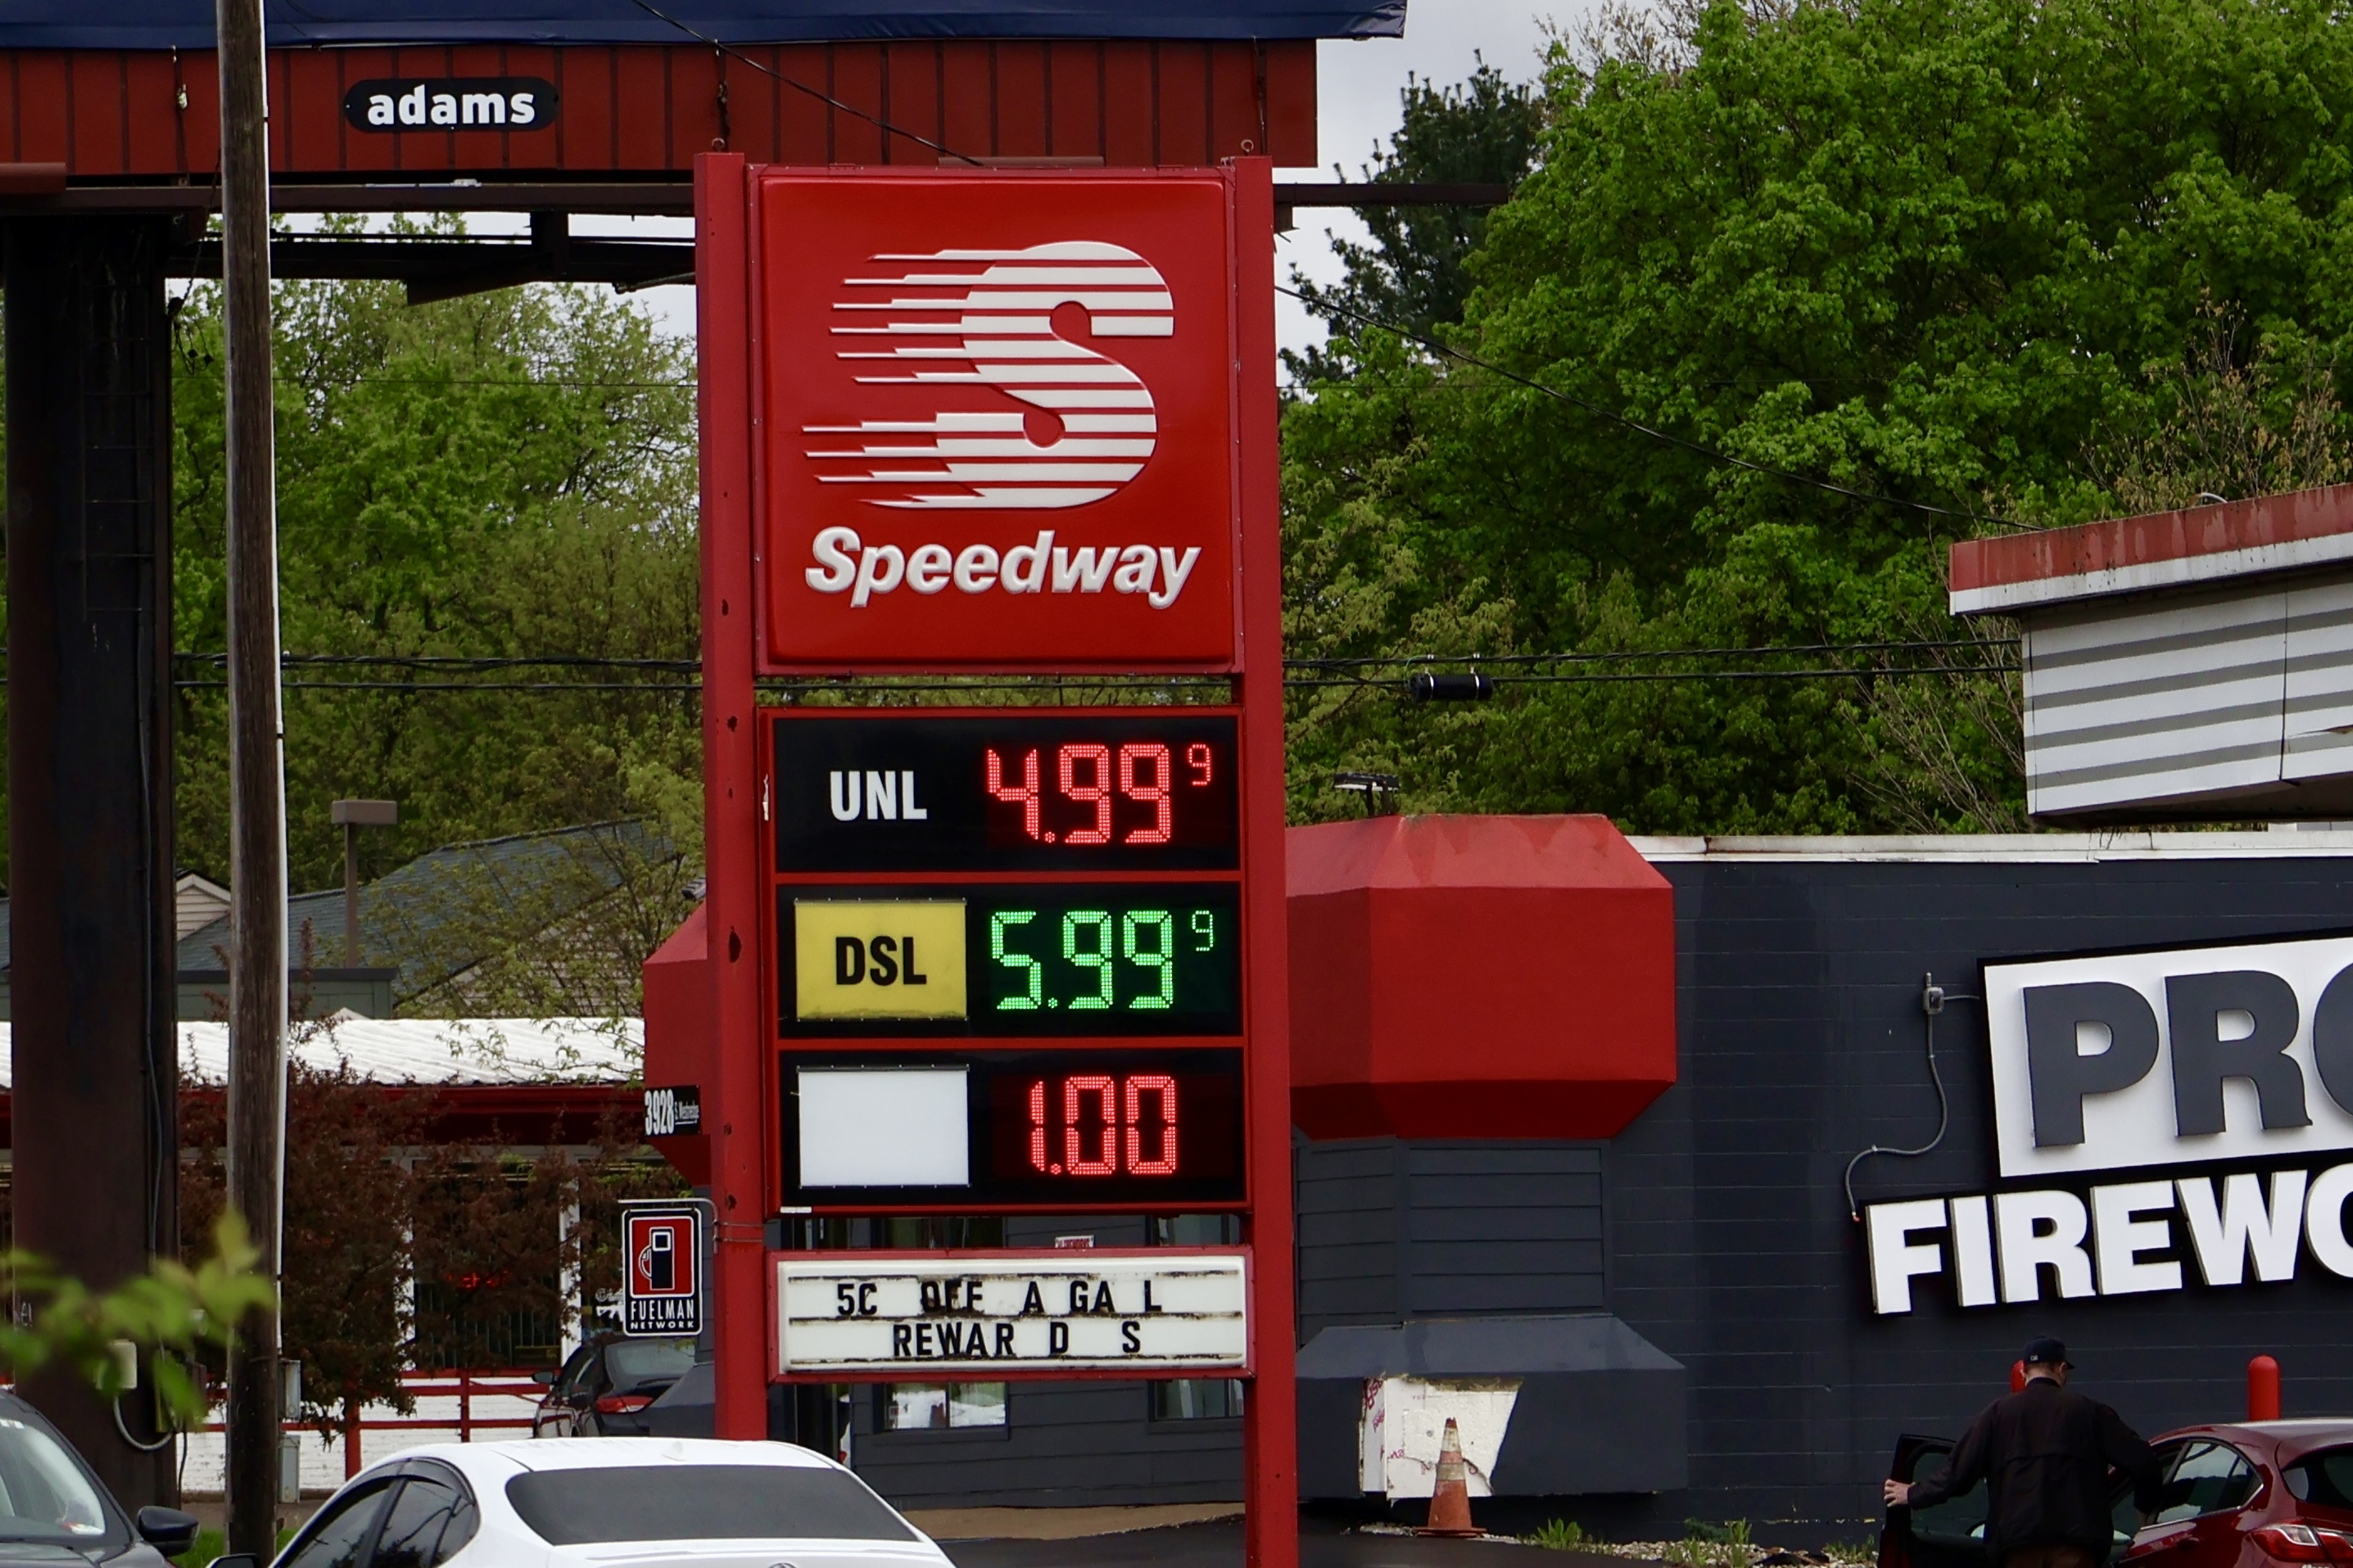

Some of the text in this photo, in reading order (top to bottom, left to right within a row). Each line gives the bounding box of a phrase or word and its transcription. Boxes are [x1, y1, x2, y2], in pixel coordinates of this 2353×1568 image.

[368, 84, 536, 126] adams
[805, 526, 1202, 609] Speedway
[830, 770, 928, 821] UNL
[835, 936, 927, 987] DSL
[645, 1088, 674, 1136] 3928
[1030, 1075, 1177, 1176] 1.00
[631, 1299, 695, 1321] FUELMAN
[631, 1320, 695, 1330] NETWORK
